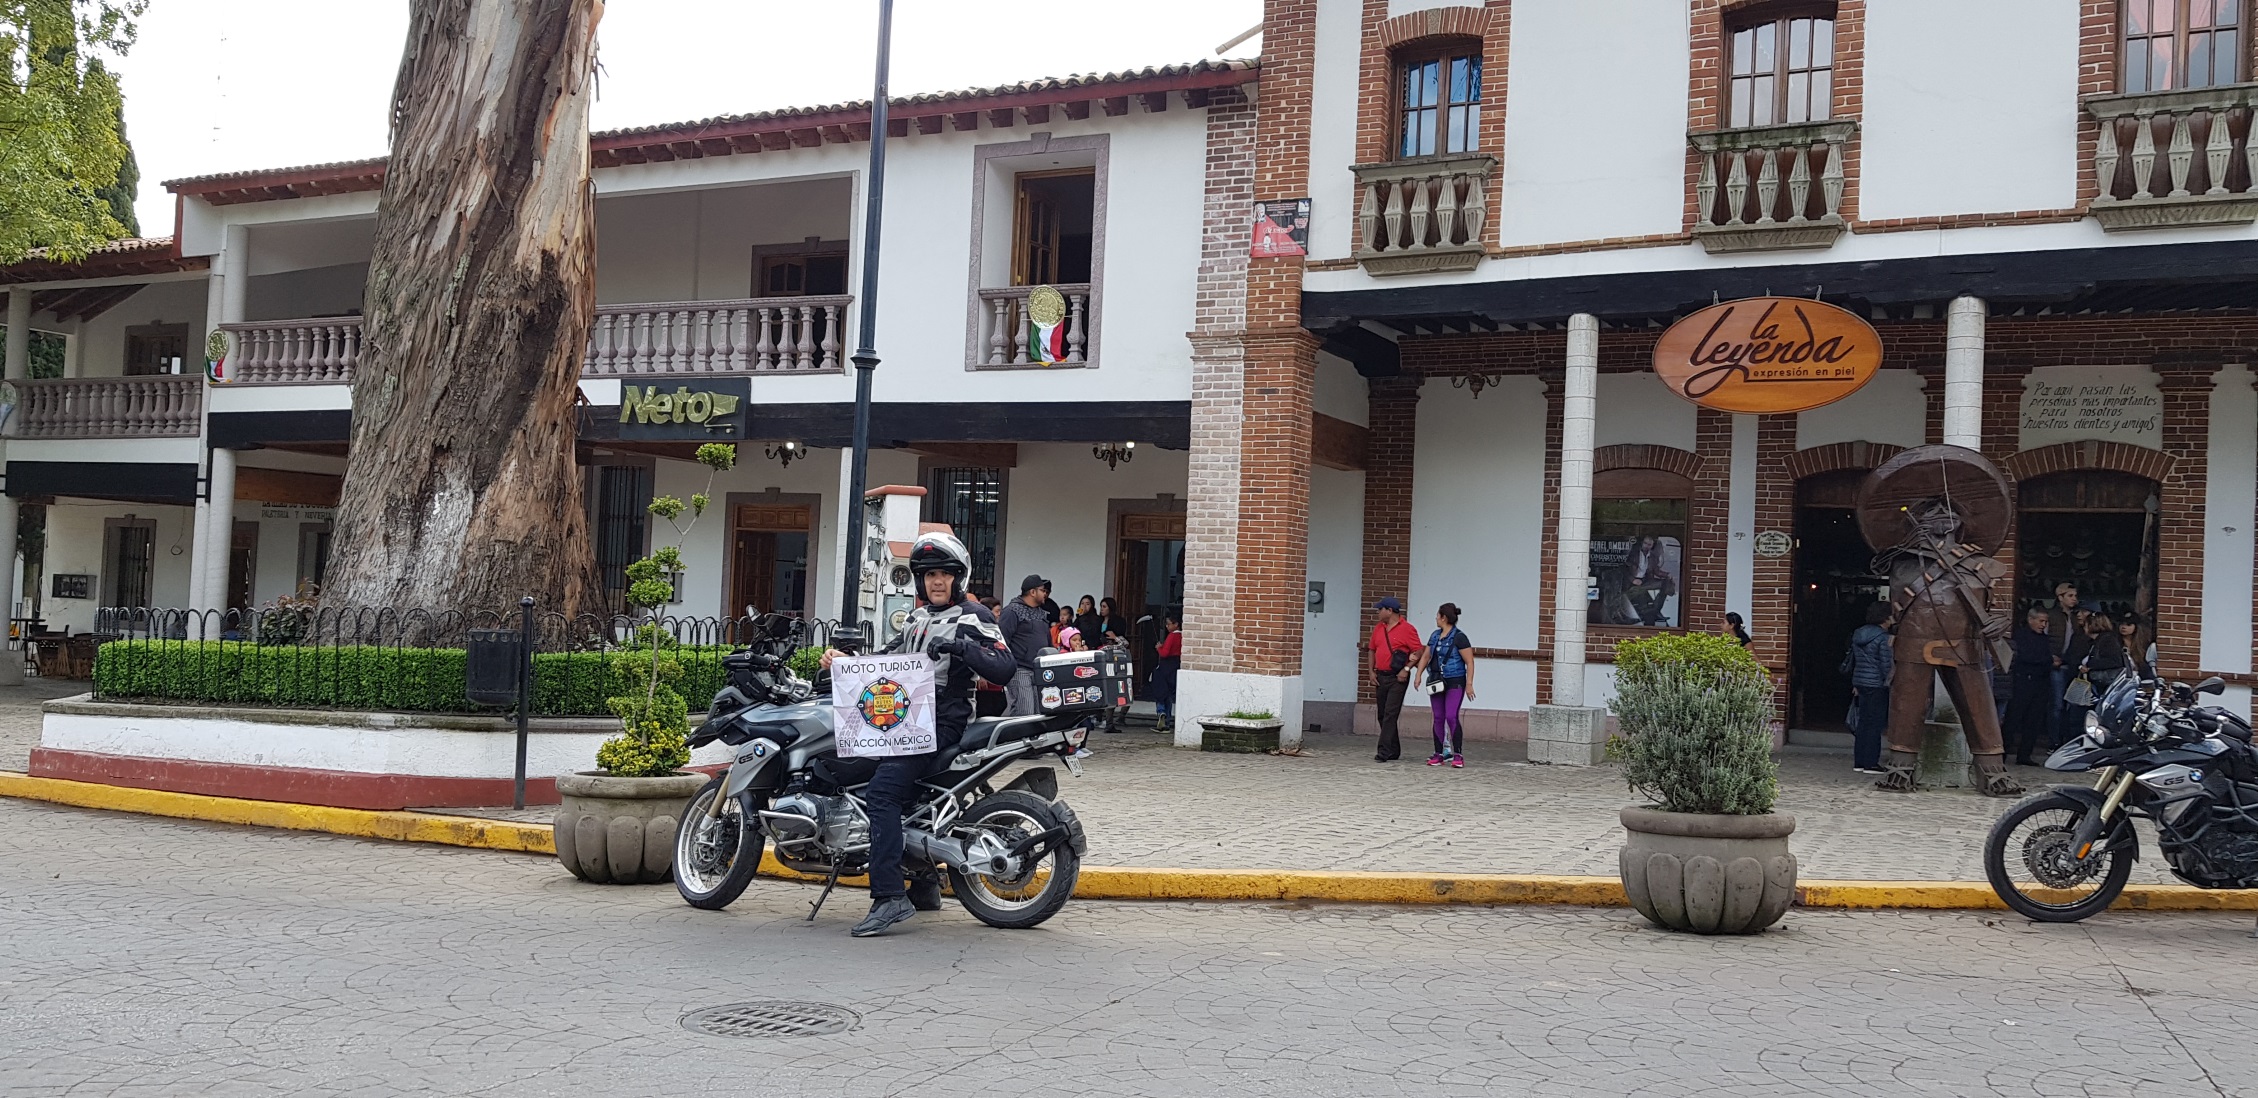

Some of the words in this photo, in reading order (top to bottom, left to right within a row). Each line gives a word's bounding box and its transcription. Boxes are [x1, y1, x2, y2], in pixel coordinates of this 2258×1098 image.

[1750, 301, 1779, 340] la
[1684, 305, 1855, 398] leyenda
[1753, 367, 1809, 378] expresión
[1835, 367, 1855, 377] piel
[2034, 381, 2052, 396] Por
[2079, 385, 2114, 397] pasan
[2119, 383, 2137, 395] las
[618, 385, 712, 425] Neto
[2028, 397, 2077, 408] personas
[2102, 395, 2157, 408] importantes
[2039, 408, 2067, 419] para
[2079, 407, 2123, 417] nosotros
[2073, 417, 2110, 430] clientes
[2110, 419, 2121, 434] y
[841, 663, 876, 674] MOTO
[879, 660, 922, 672] TURISTA
[839, 739, 851, 748] EN
[853, 736, 892, 748] ACCIÓN
[893, 733, 932, 746] MÉXICO
[738, 752, 754, 765] GS
[2163, 775, 2185, 786] GS
